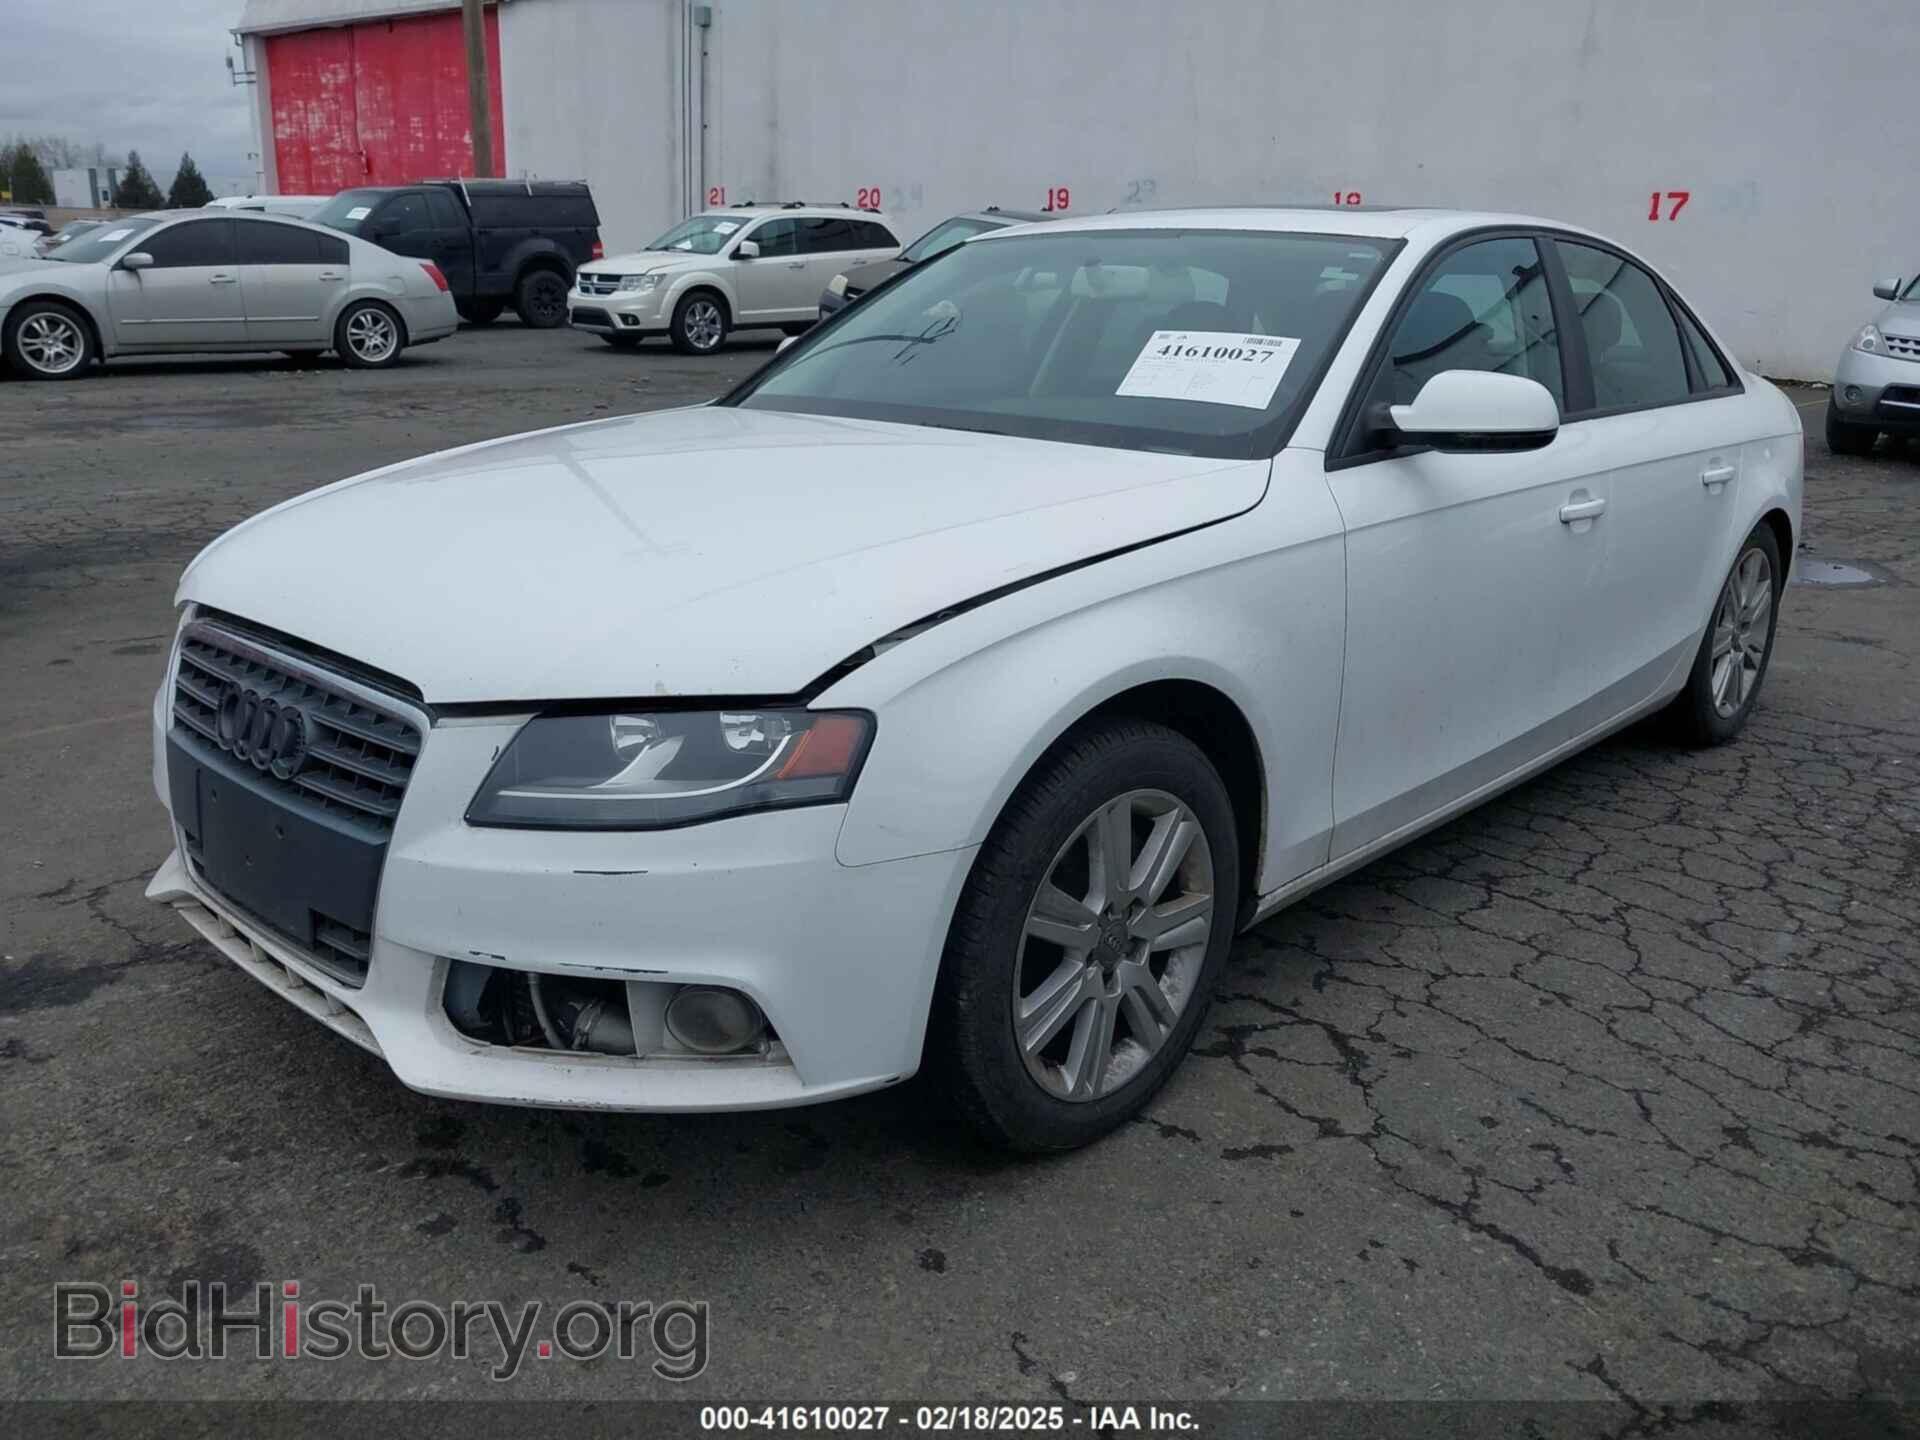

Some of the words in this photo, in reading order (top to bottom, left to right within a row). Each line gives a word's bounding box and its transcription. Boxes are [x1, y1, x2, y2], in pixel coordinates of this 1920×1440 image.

[708, 187, 726, 206] 21
[857, 187, 881, 208] 20
[1047, 187, 1070, 210] 19
[1648, 191, 1690, 221] 17
[1156, 343, 1274, 363] 41610027
